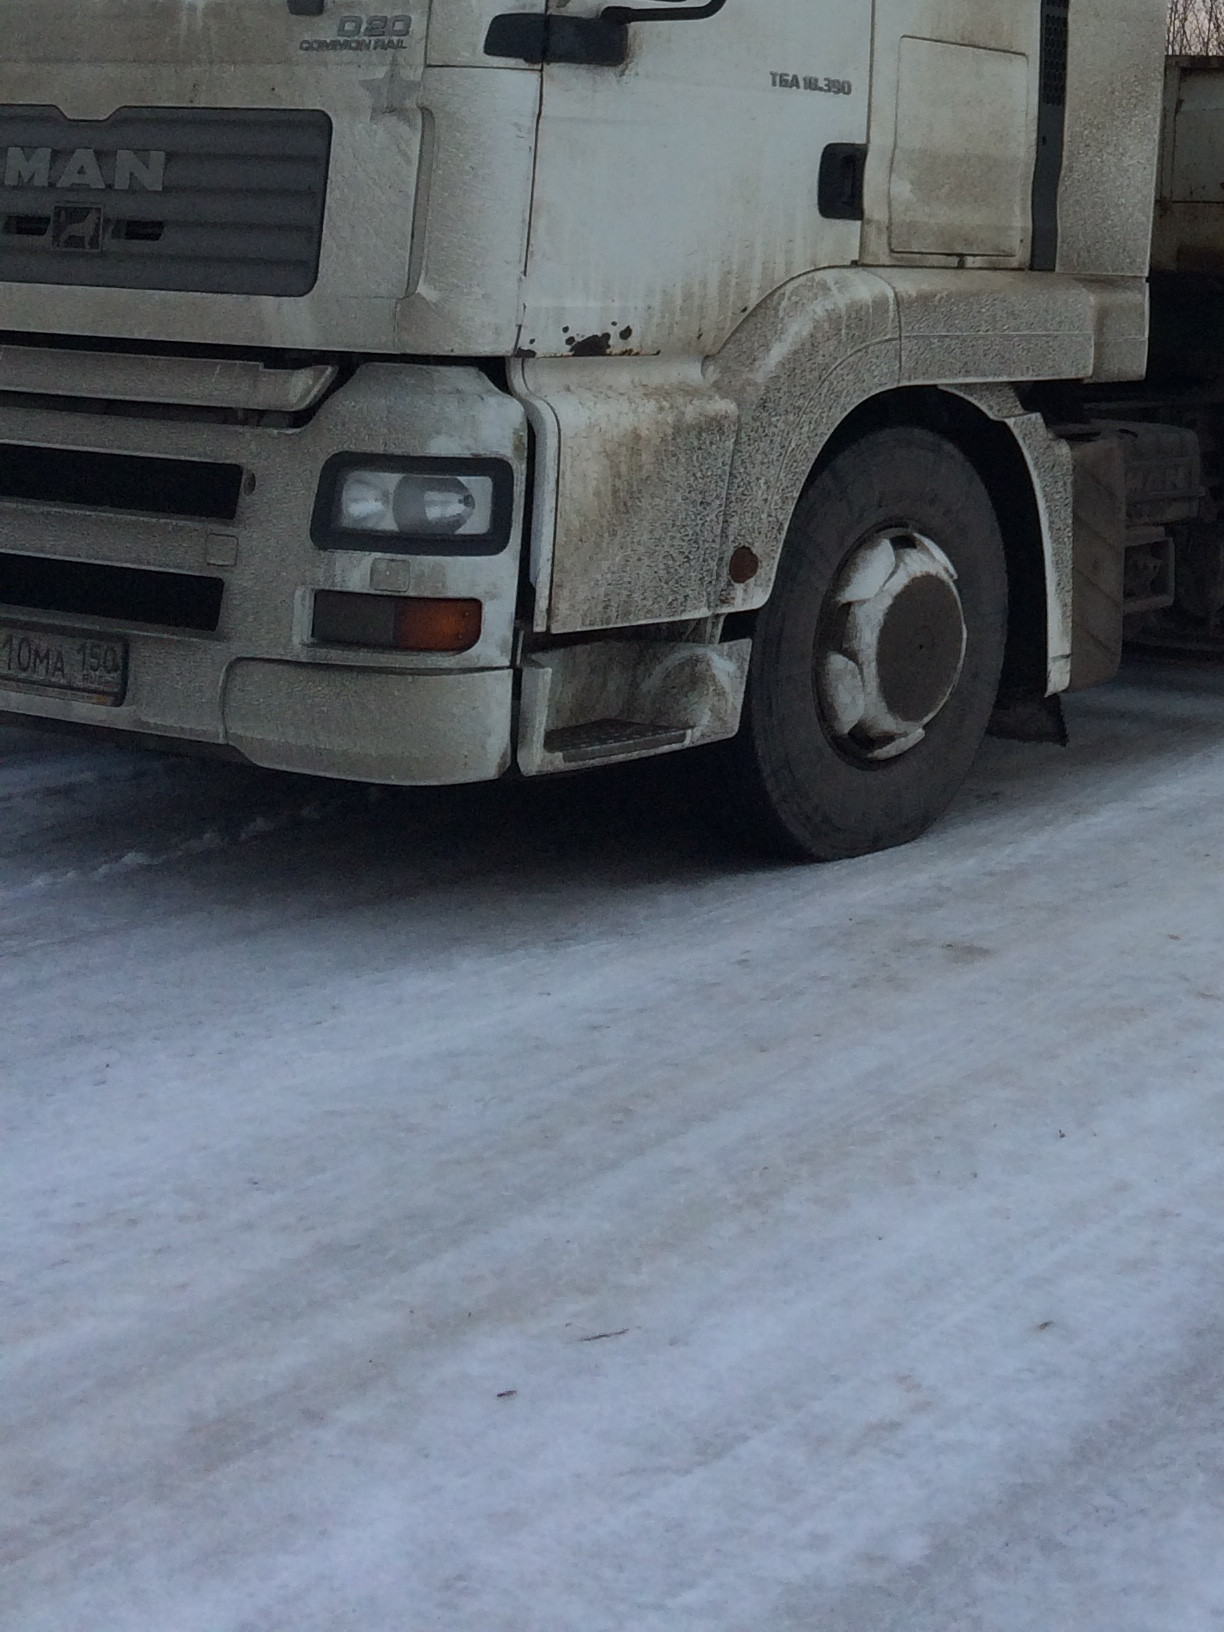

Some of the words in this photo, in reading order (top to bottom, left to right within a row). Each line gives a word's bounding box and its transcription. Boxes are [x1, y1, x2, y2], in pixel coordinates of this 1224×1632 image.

[336, 15, 412, 37] D20
[299, 39, 371, 52] COMMON
[373, 39, 408, 50] RAIL
[769, 71, 800, 89] TGA
[4, 147, 166, 191] MAN
